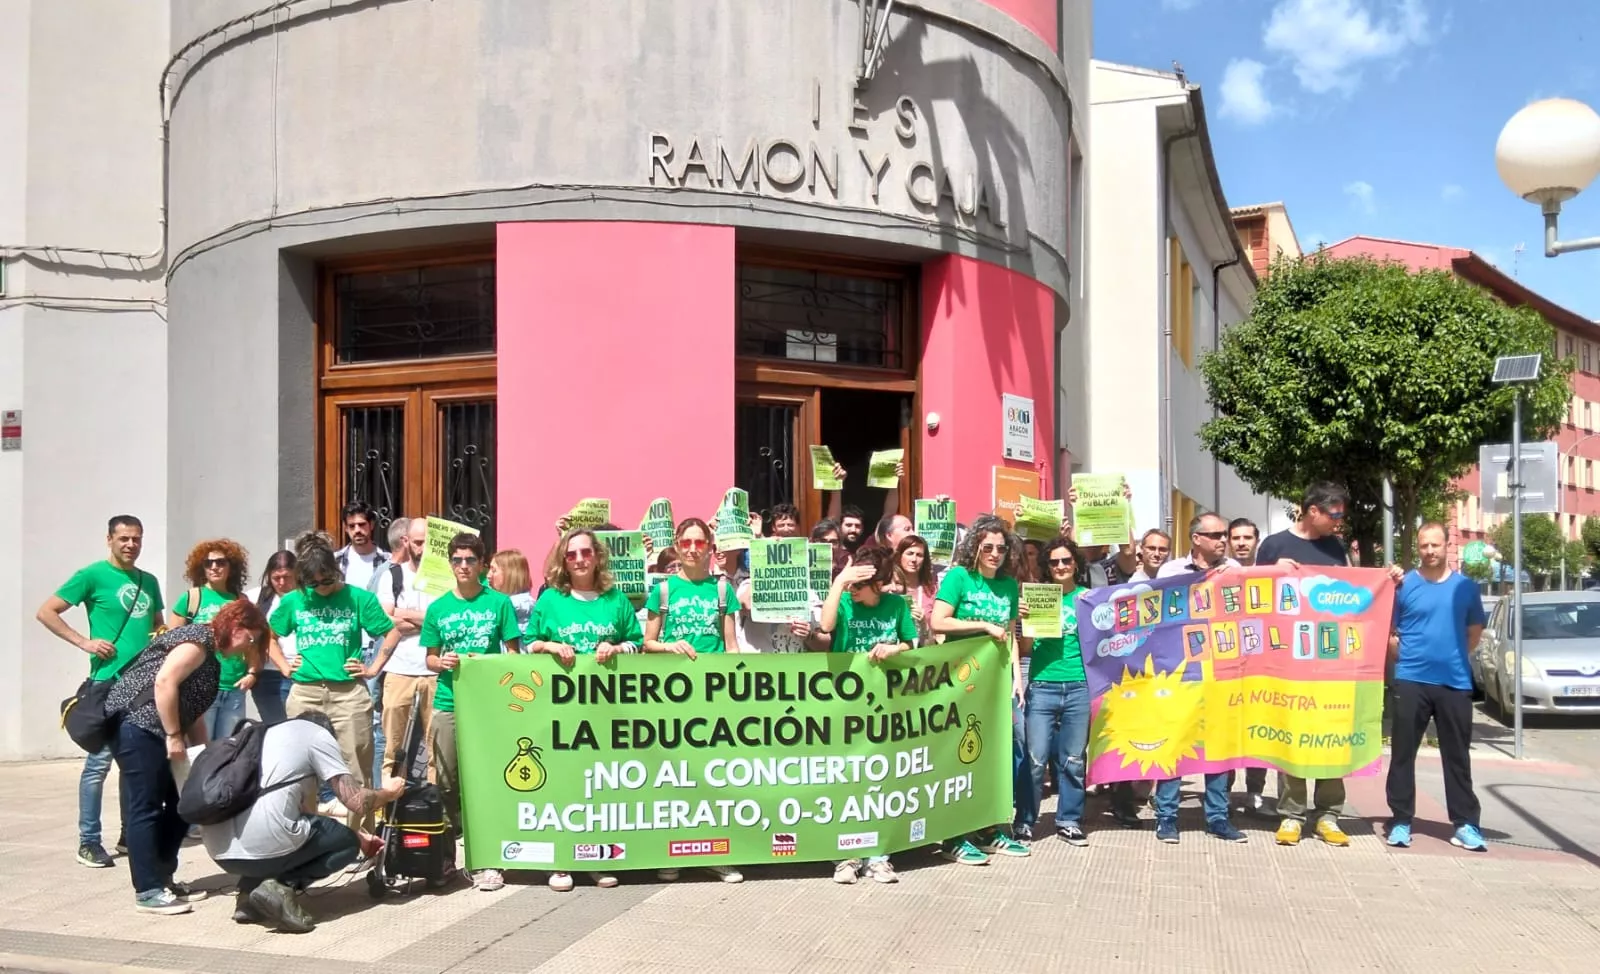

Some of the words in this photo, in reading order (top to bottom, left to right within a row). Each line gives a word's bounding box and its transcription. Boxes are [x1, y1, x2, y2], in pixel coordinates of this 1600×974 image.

[649, 133, 839, 198] RAMON
[859, 149, 891, 205] Y
[649, 502, 669, 520] NO!
[928, 503, 948, 521] NO!
[606, 536, 630, 557] NO!
[767, 543, 793, 565] NO!
[635, 571, 645, 581] EN
[754, 568, 763, 579] AL
[764, 566, 807, 578] CONCIERTO
[754, 579, 797, 591] EDUCATIVO
[797, 578, 807, 589] EN
[752, 591, 808, 603] BACHILLERATO
[1119, 582, 1300, 626] ESCUELA
[1317, 592, 1360, 606] CRÍTICA
[552, 672, 693, 704] DINERO
[705, 661, 875, 705] PÚBLICO,
[886, 661, 954, 699] PARA
[1228, 691, 1245, 707] LA
[1250, 690, 1317, 711] NUESTRA
[552, 719, 600, 750] LA
[611, 705, 831, 748] EDUCACIÓN
[844, 701, 962, 745] PÚBLICA
[1247, 725, 1293, 746] TODOS
[1299, 732, 1366, 749] PINTAMOS
[584, 760, 647, 799] ¡NO
[653, 760, 697, 788] AL
[704, 754, 889, 787] CONCIERTO
[895, 746, 933, 779] DEL
[518, 797, 770, 833] BACHILLERATO,
[779, 797, 833, 826] 0-3
[840, 785, 920, 823] AÑOS
[924, 781, 941, 809] Y
[943, 771, 973, 805] FP!
[577, 844, 596, 852] CGT
[671, 841, 711, 854] CCOO
[839, 839, 856, 847] UGT
